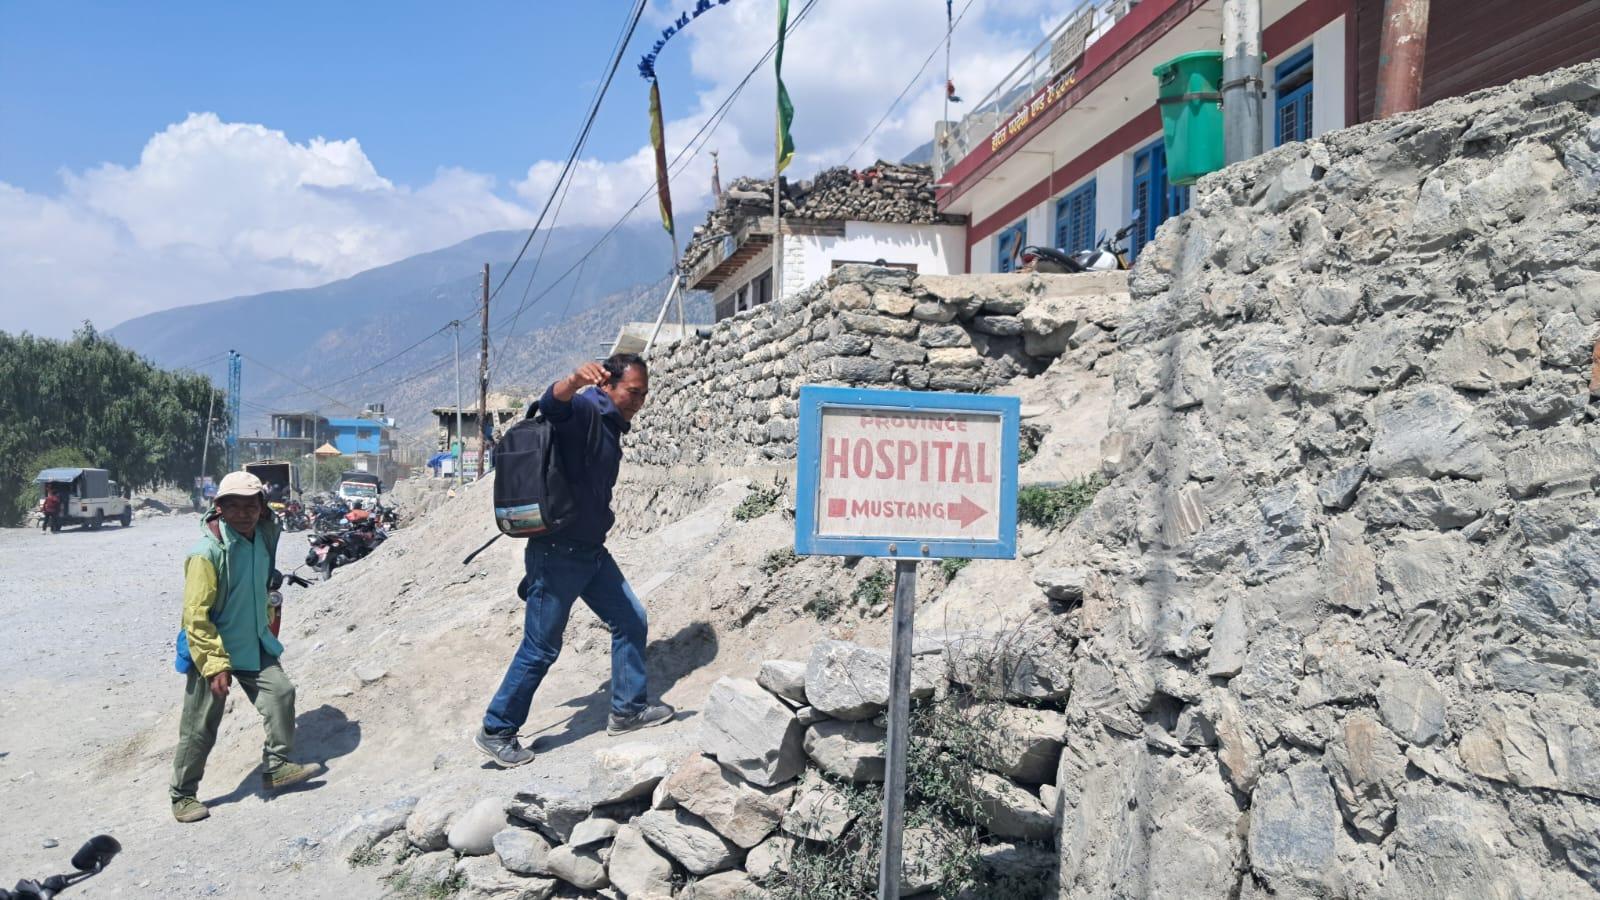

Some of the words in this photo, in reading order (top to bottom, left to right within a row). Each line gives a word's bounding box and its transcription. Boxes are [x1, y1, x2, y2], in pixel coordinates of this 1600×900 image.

[991, 125, 1007, 152] होटल
[859, 414, 968, 433] PROVINCE
[824, 437, 993, 484] HOSPITAL
[851, 499, 945, 520] MUSTANG
